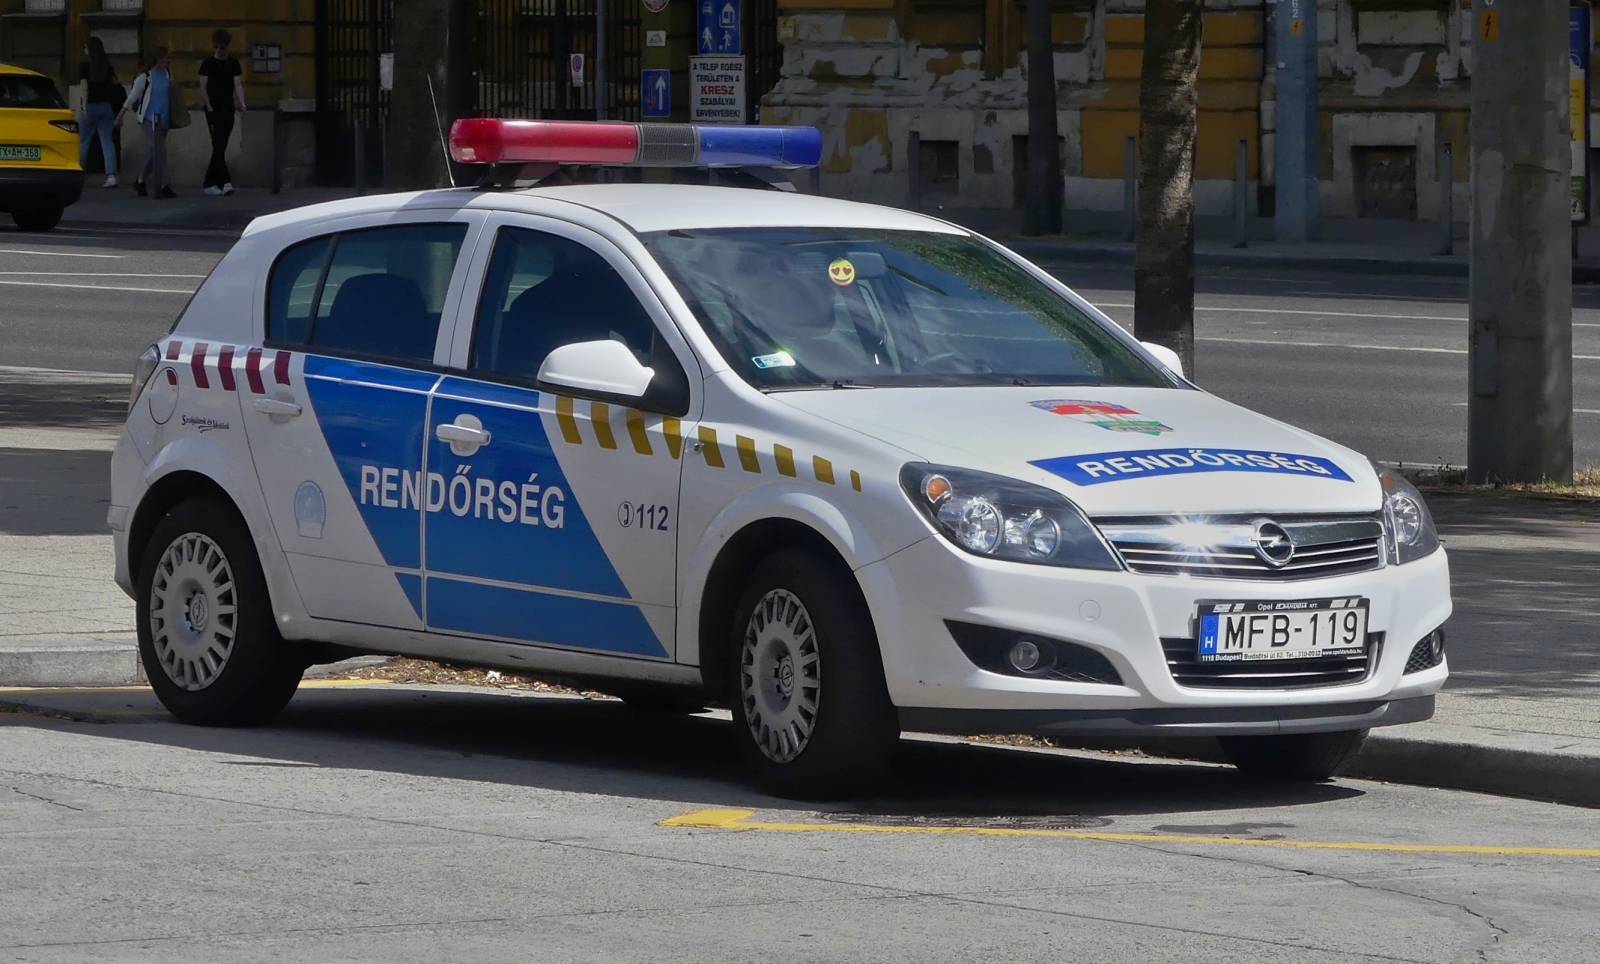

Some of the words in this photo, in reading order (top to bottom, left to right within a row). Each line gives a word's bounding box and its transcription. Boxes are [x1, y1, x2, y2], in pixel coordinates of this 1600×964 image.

[699, 63, 719, 71] TELEP
[720, 62, 743, 71] EGÉSZ
[696, 73, 734, 82] TERÜLETÉN
[700, 85, 735, 95] KRESZ
[700, 96, 736, 106] SZABÁLYAI
[695, 107, 741, 117] ÉRVÉNYESEK!
[1076, 449, 1333, 478] RENDŐRSÉG
[360, 464, 565, 529] RENDŐRSÉG
[636, 504, 669, 531] 112
[1257, 603, 1273, 611] Opel
[1225, 611, 1358, 649] MFB-119
[1204, 636, 1213, 648] H
[1215, 653, 1242, 662] Budapest
